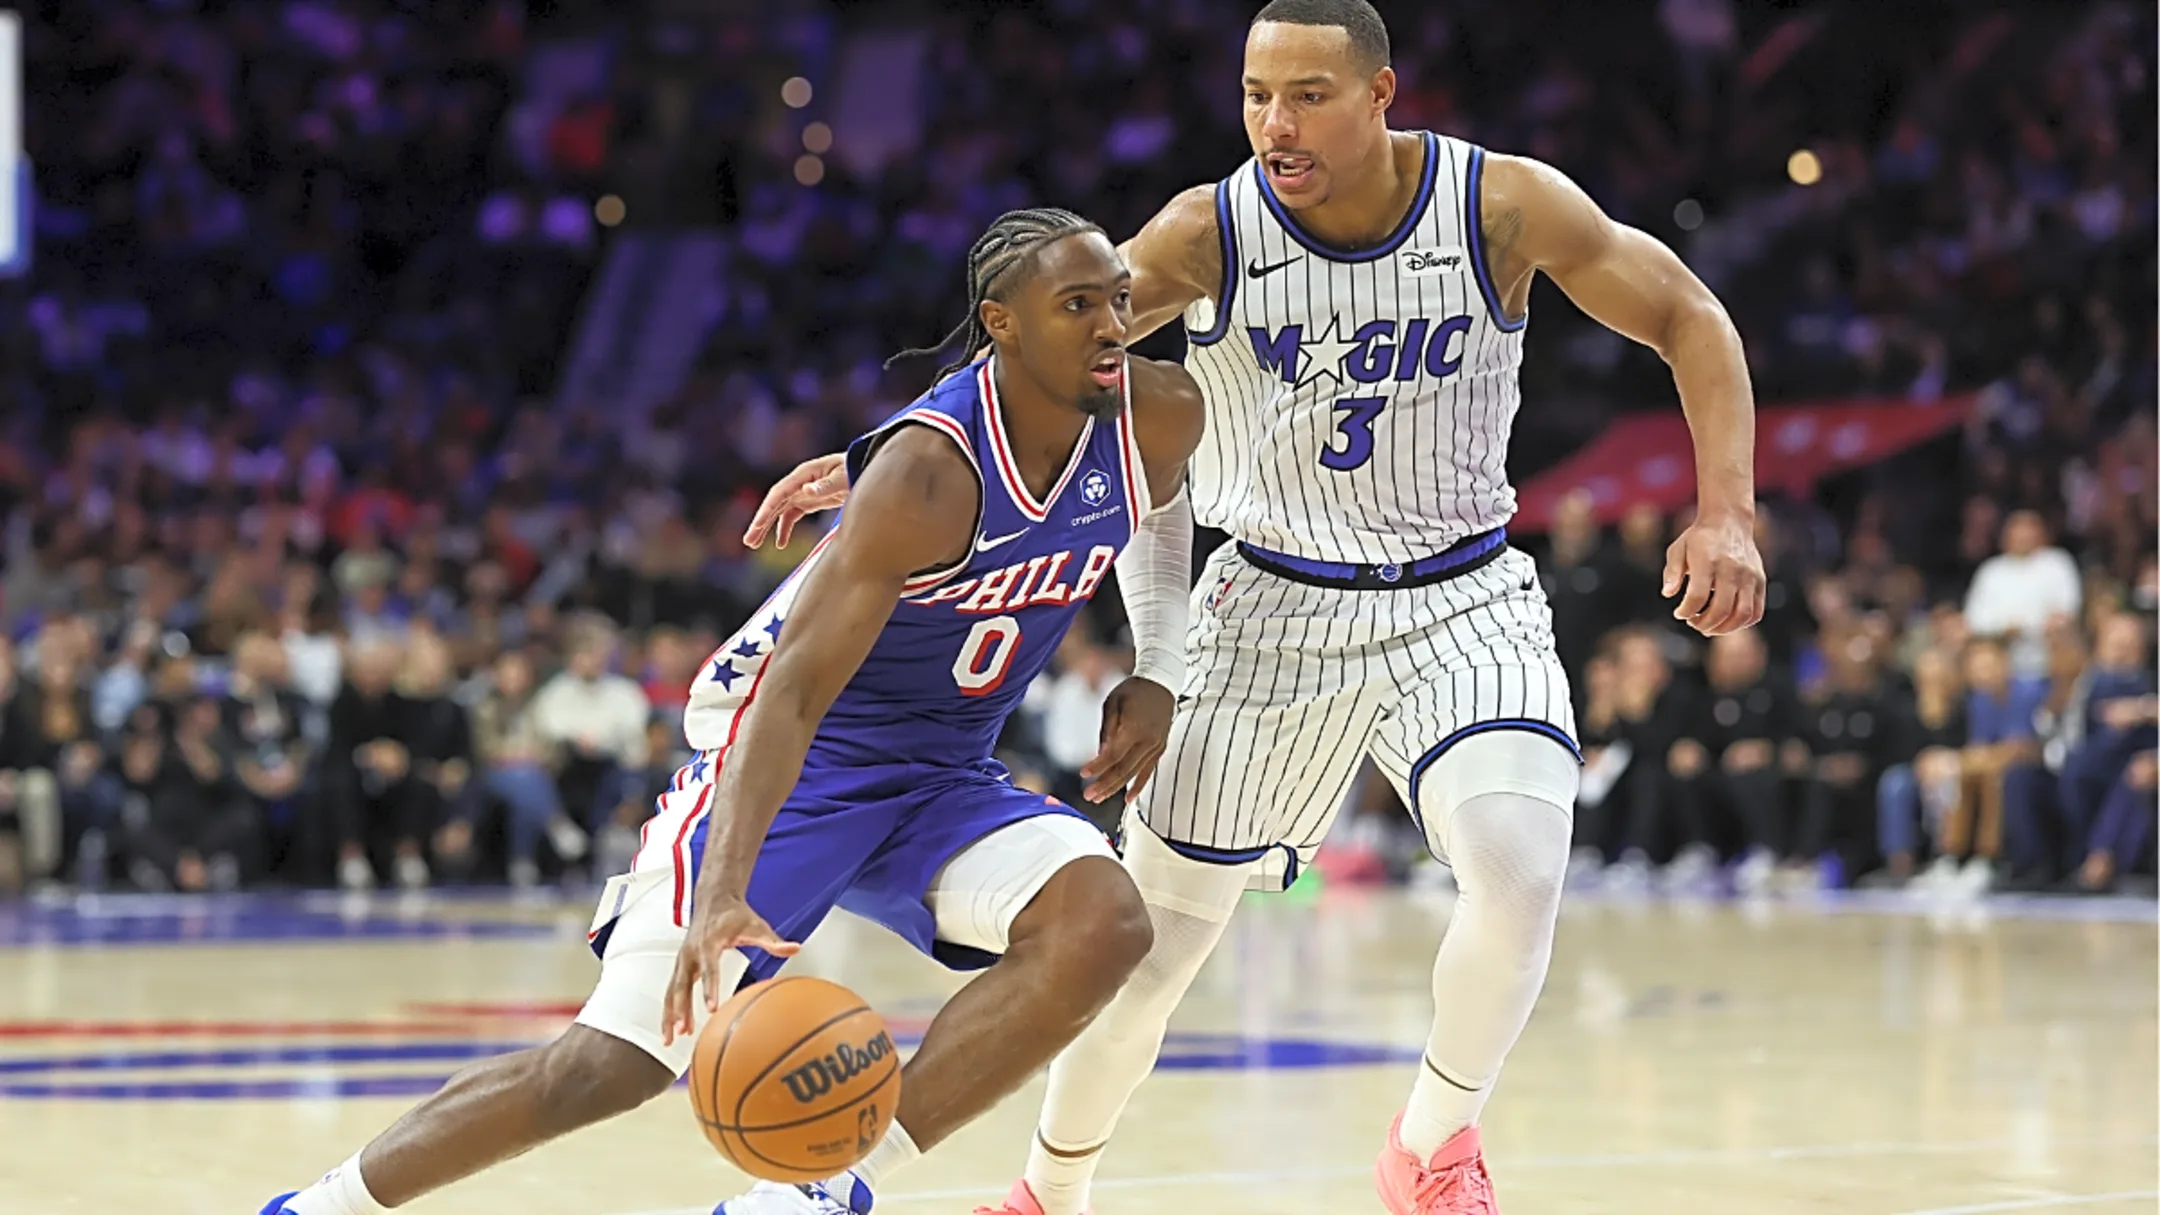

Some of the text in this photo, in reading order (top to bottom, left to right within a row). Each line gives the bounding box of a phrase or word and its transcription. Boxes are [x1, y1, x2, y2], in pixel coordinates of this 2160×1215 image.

[1402, 251, 1462, 272] Disney
[1318, 396, 1388, 472] 3
[905, 545, 1117, 613] PHILA
[951, 614, 1023, 696] 0
[780, 1029, 893, 1103] Wilson
